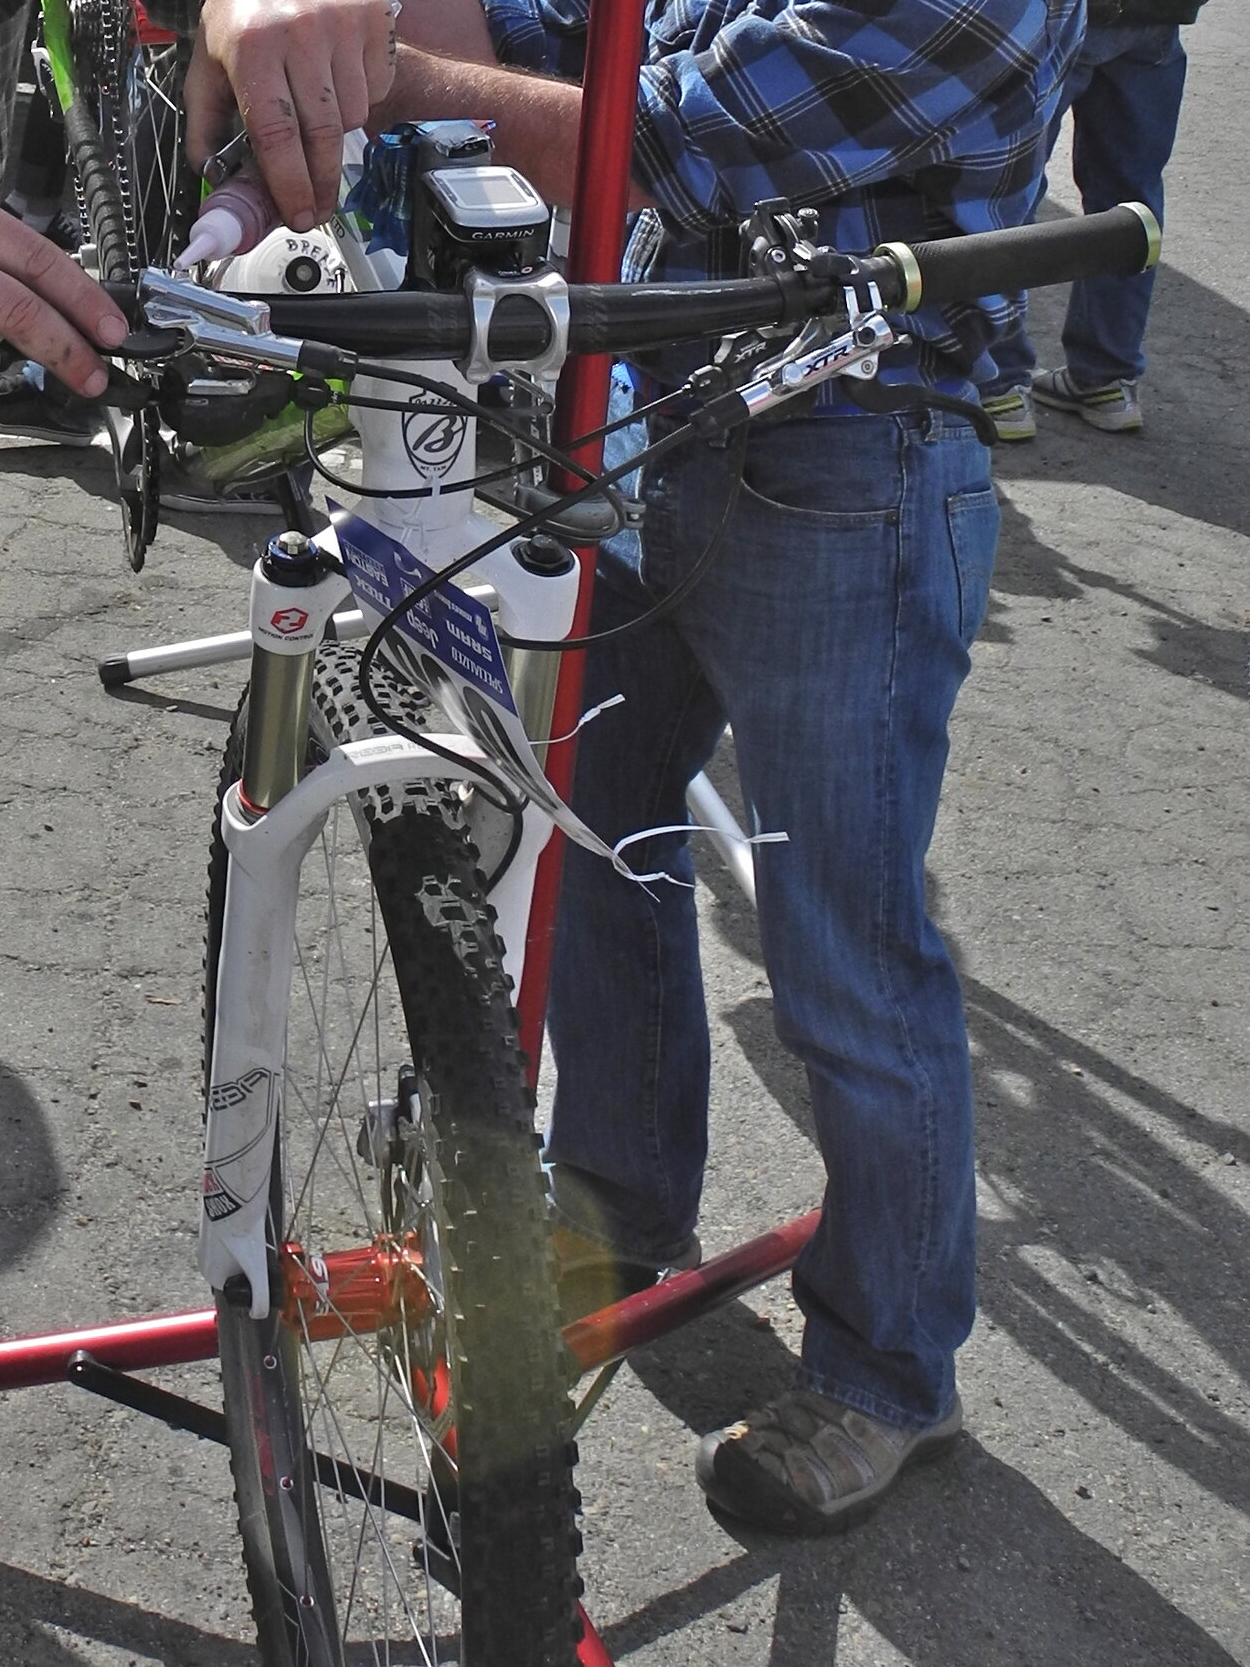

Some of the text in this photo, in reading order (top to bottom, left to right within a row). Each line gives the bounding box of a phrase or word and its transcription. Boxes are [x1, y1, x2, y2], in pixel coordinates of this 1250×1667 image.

[471, 228, 535, 240] GARMIN
[734, 341, 767, 364] XTR
[803, 345, 850, 377] XTR
[406, 609, 439, 649] Jeep
[445, 619, 492, 662] SRAM
[451, 646, 503, 694] SPECIALIZED
